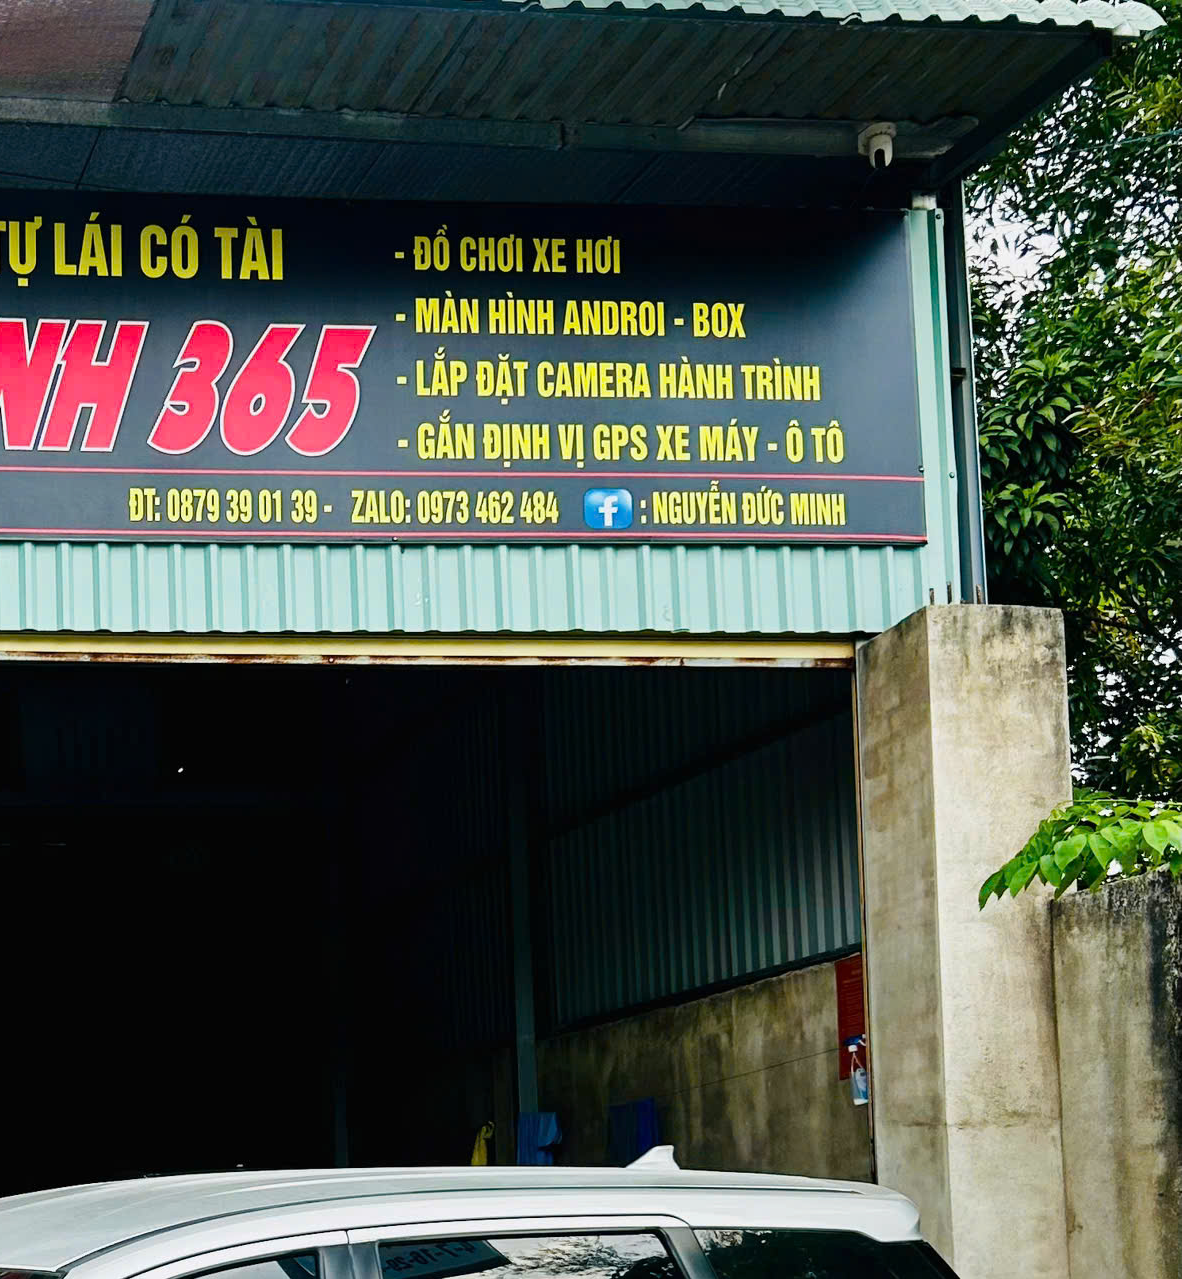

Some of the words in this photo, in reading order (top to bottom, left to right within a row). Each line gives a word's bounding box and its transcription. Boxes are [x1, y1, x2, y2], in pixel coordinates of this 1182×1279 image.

[54, 212, 122, 276] LÁI
[141, 215, 198, 279] CÓ
[215, 217, 283, 280] TÀI
[414, 225, 449, 271] ĐỒ
[460, 235, 522, 272] CHƠI
[533, 239, 566, 272] XE
[577, 236, 620, 273] HƠI
[416, 291, 479, 333] MÀN
[489, 292, 554, 335] HÌNH
[563, 300, 665, 336] ANDROI
[693, 303, 746, 338] BOX
[146, 320, 378, 457] 365
[416, 347, 467, 397] LẮP
[476, 355, 528, 404] ĐẶT
[537, 361, 651, 400] CAMERA
[658, 357, 734, 400] HÀNH
[741, 358, 822, 402] TRÌNH
[416, 411, 476, 461] GẮN
[482, 423, 550, 467] ĐỊNH
[557, 424, 586, 467] VỊ
[592, 424, 648, 462] GPS
[656, 424, 690, 462] XE
[698, 421, 759, 462] MÁY
[786, 420, 805, 464] Ô
[810, 421, 845, 464] TÔ
[128, 488, 162, 521] ĐT:
[166, 488, 220, 522] 0879
[226, 488, 253, 524] 39
[258, 488, 282, 522] 01
[292, 488, 317, 523] 39
[352, 489, 412, 524] ZALO:
[416, 490, 470, 524] 0973
[475, 491, 514, 524] 462
[520, 491, 559, 524] 484
[652, 481, 738, 525] NGUYỄN
[742, 488, 786, 526] ĐỨC
[789, 493, 846, 526] MINH
